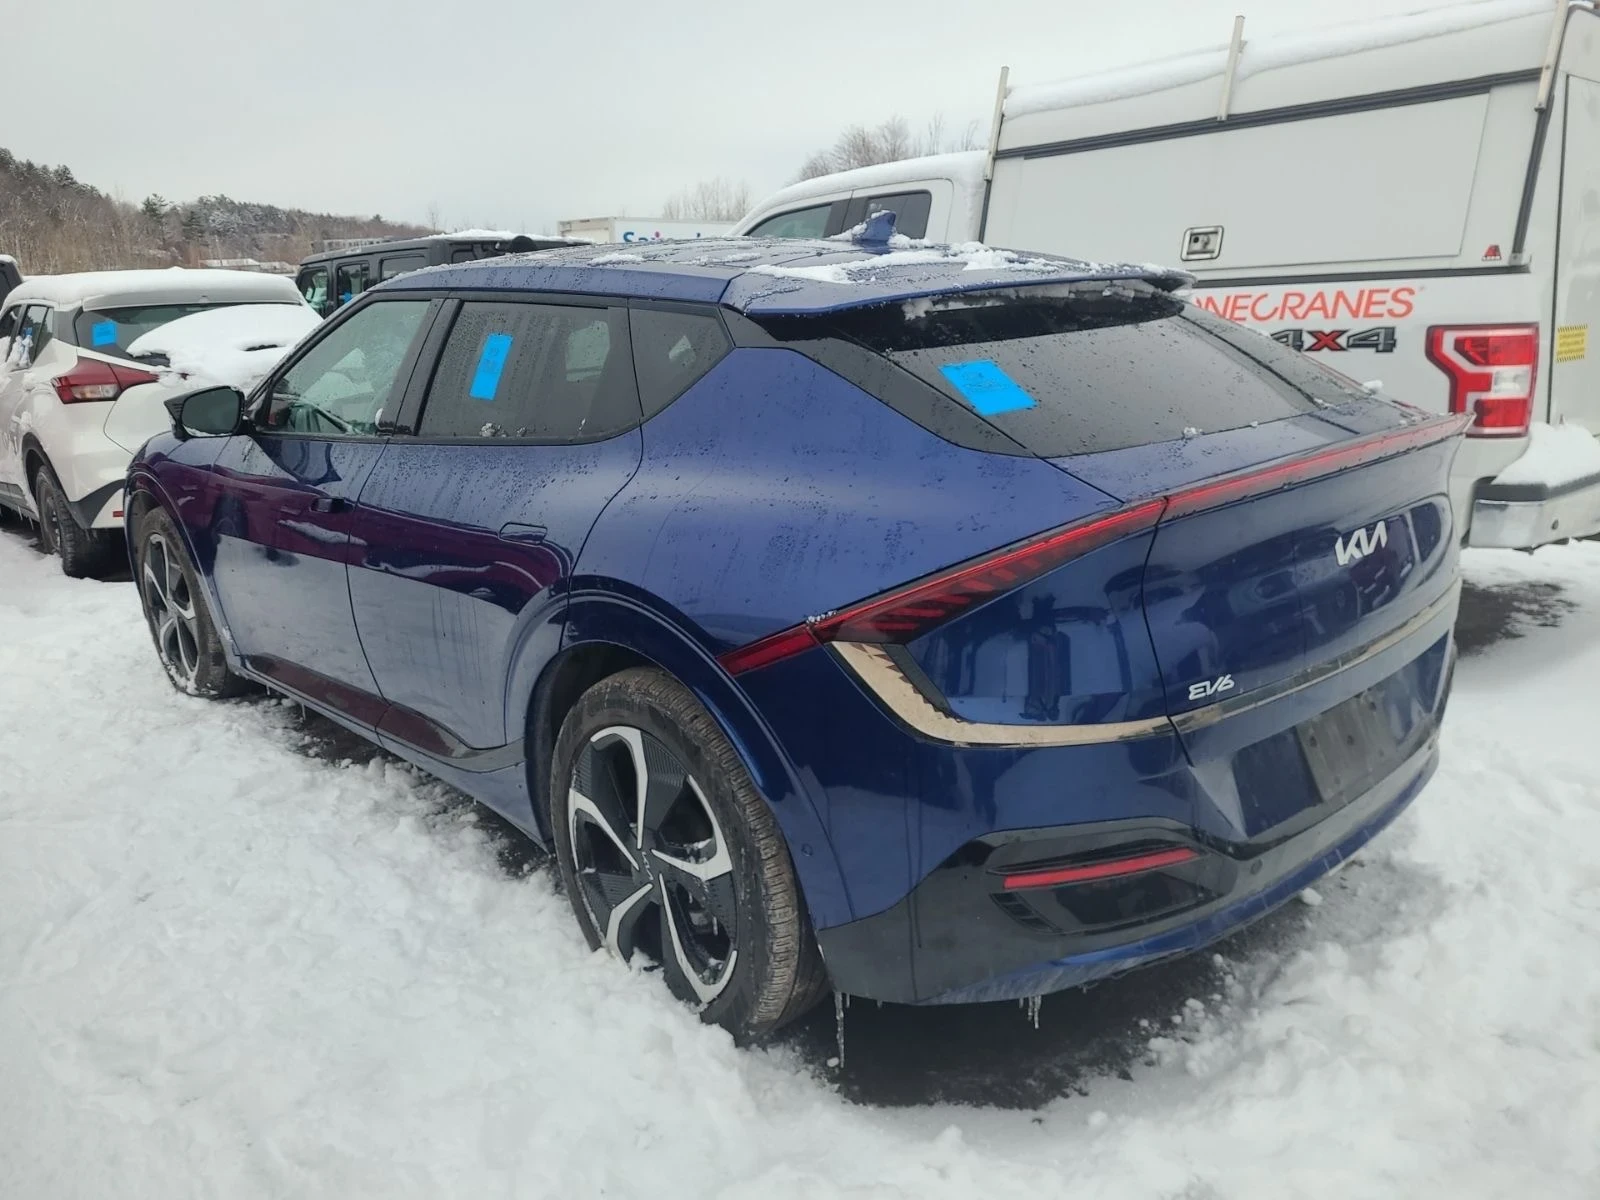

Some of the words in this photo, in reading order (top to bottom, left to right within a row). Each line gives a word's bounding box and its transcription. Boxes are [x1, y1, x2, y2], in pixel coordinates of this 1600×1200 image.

[1196, 287, 1415, 322] NECRANES
[1335, 520, 1387, 566] KIA
[1189, 673, 1235, 700] EV6
